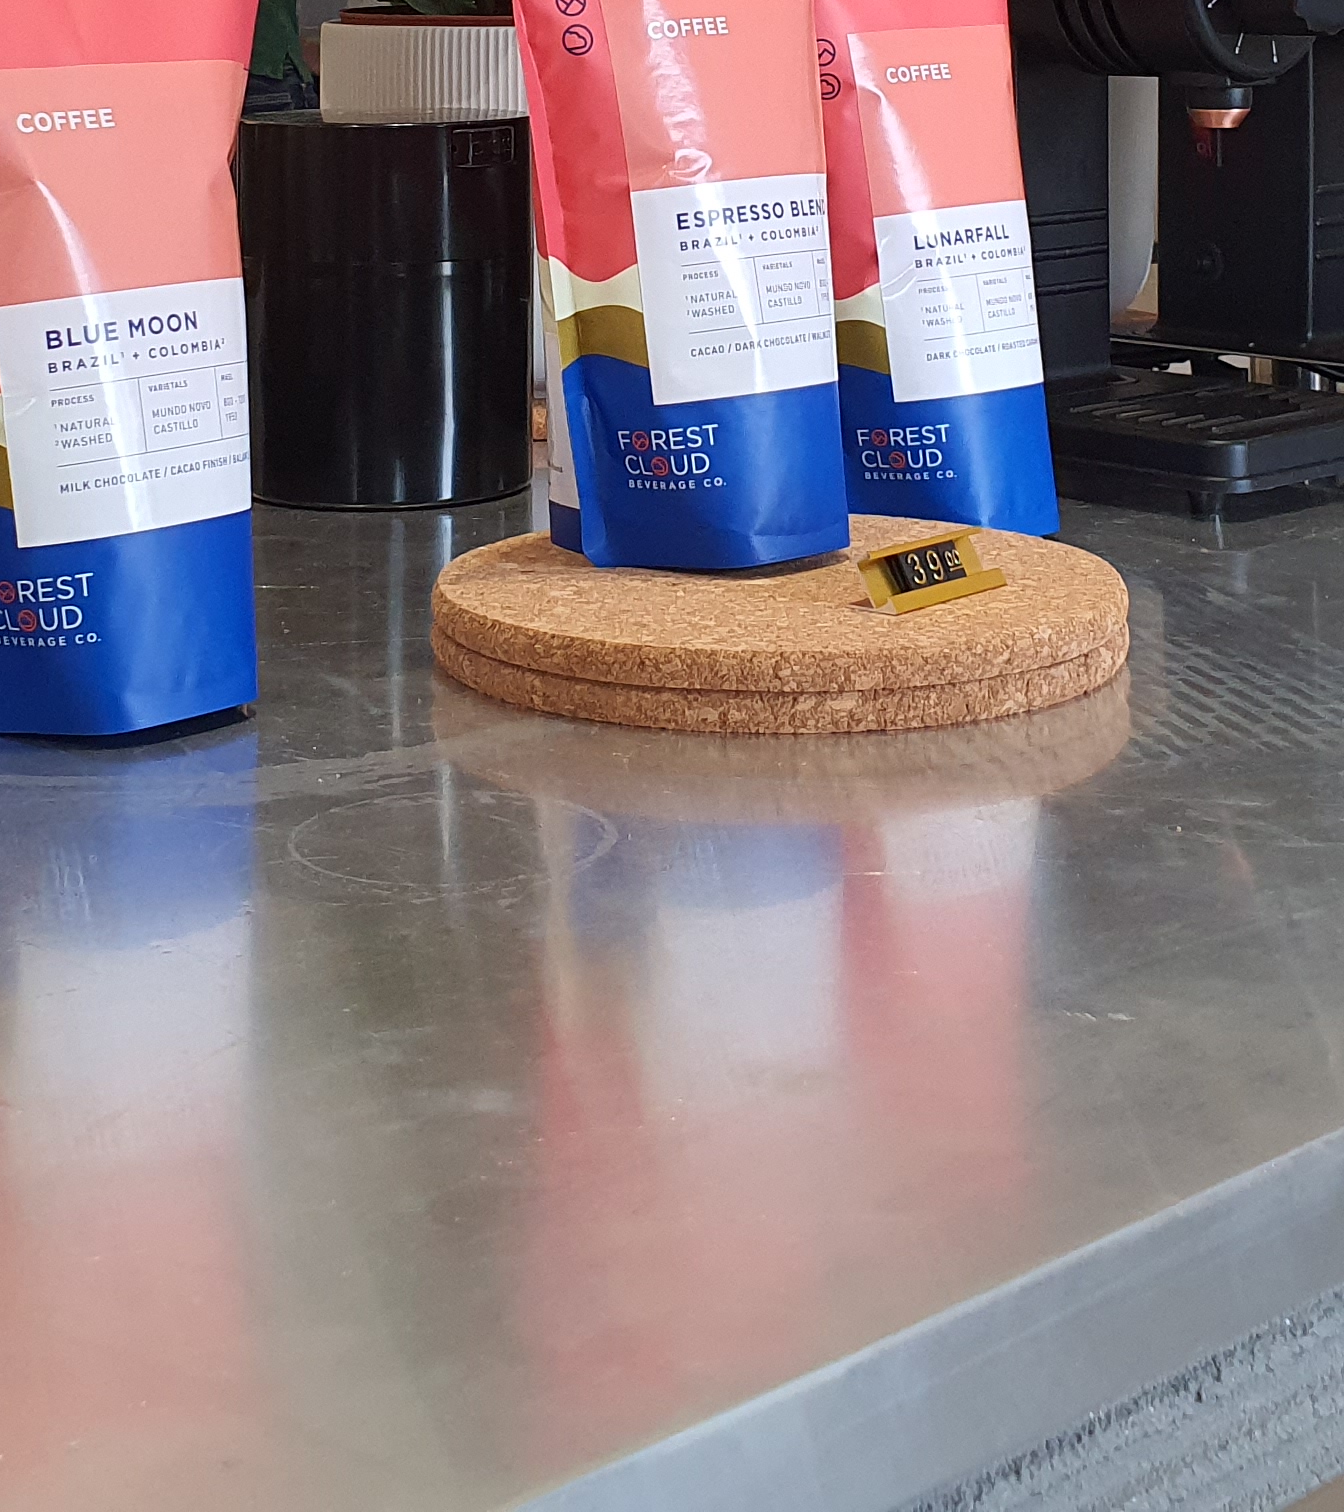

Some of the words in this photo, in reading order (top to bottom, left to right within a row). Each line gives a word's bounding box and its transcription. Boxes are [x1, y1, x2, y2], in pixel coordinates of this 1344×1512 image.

[648, 16, 729, 39] COFFEE
[886, 63, 952, 84] COFFEE
[16, 107, 116, 134] COFFEE
[676, 202, 784, 231] ESPRESSO
[914, 224, 1010, 251] LUNARFALL
[682, 270, 719, 281] PROCESS
[45, 321, 119, 350] BLUE
[128, 311, 199, 339] MOON
[690, 344, 725, 358] CACAO
[735, 340, 762, 352] DARK
[763, 333, 807, 348] CHOCOLATE
[51, 394, 95, 408] PROCESS
[152, 404, 187, 419] MUNDO
[189, 400, 212, 413] NOVO
[154, 419, 199, 435] CASTILLO
[617, 423, 719, 451] FOREST
[856, 423, 950, 448] FOREST
[625, 452, 711, 477] CLOUD
[861, 448, 943, 469] CLOUD
[60, 480, 91, 494] MILK
[94, 469, 161, 489] CHOCOLATE
[170, 461, 201, 476] CACAO
[628, 479, 696, 491] BEVERAGE
[703, 476, 727, 487] CO.
[864, 471, 930, 481] BEVERAGE
[74, 632, 102, 645] CO.
